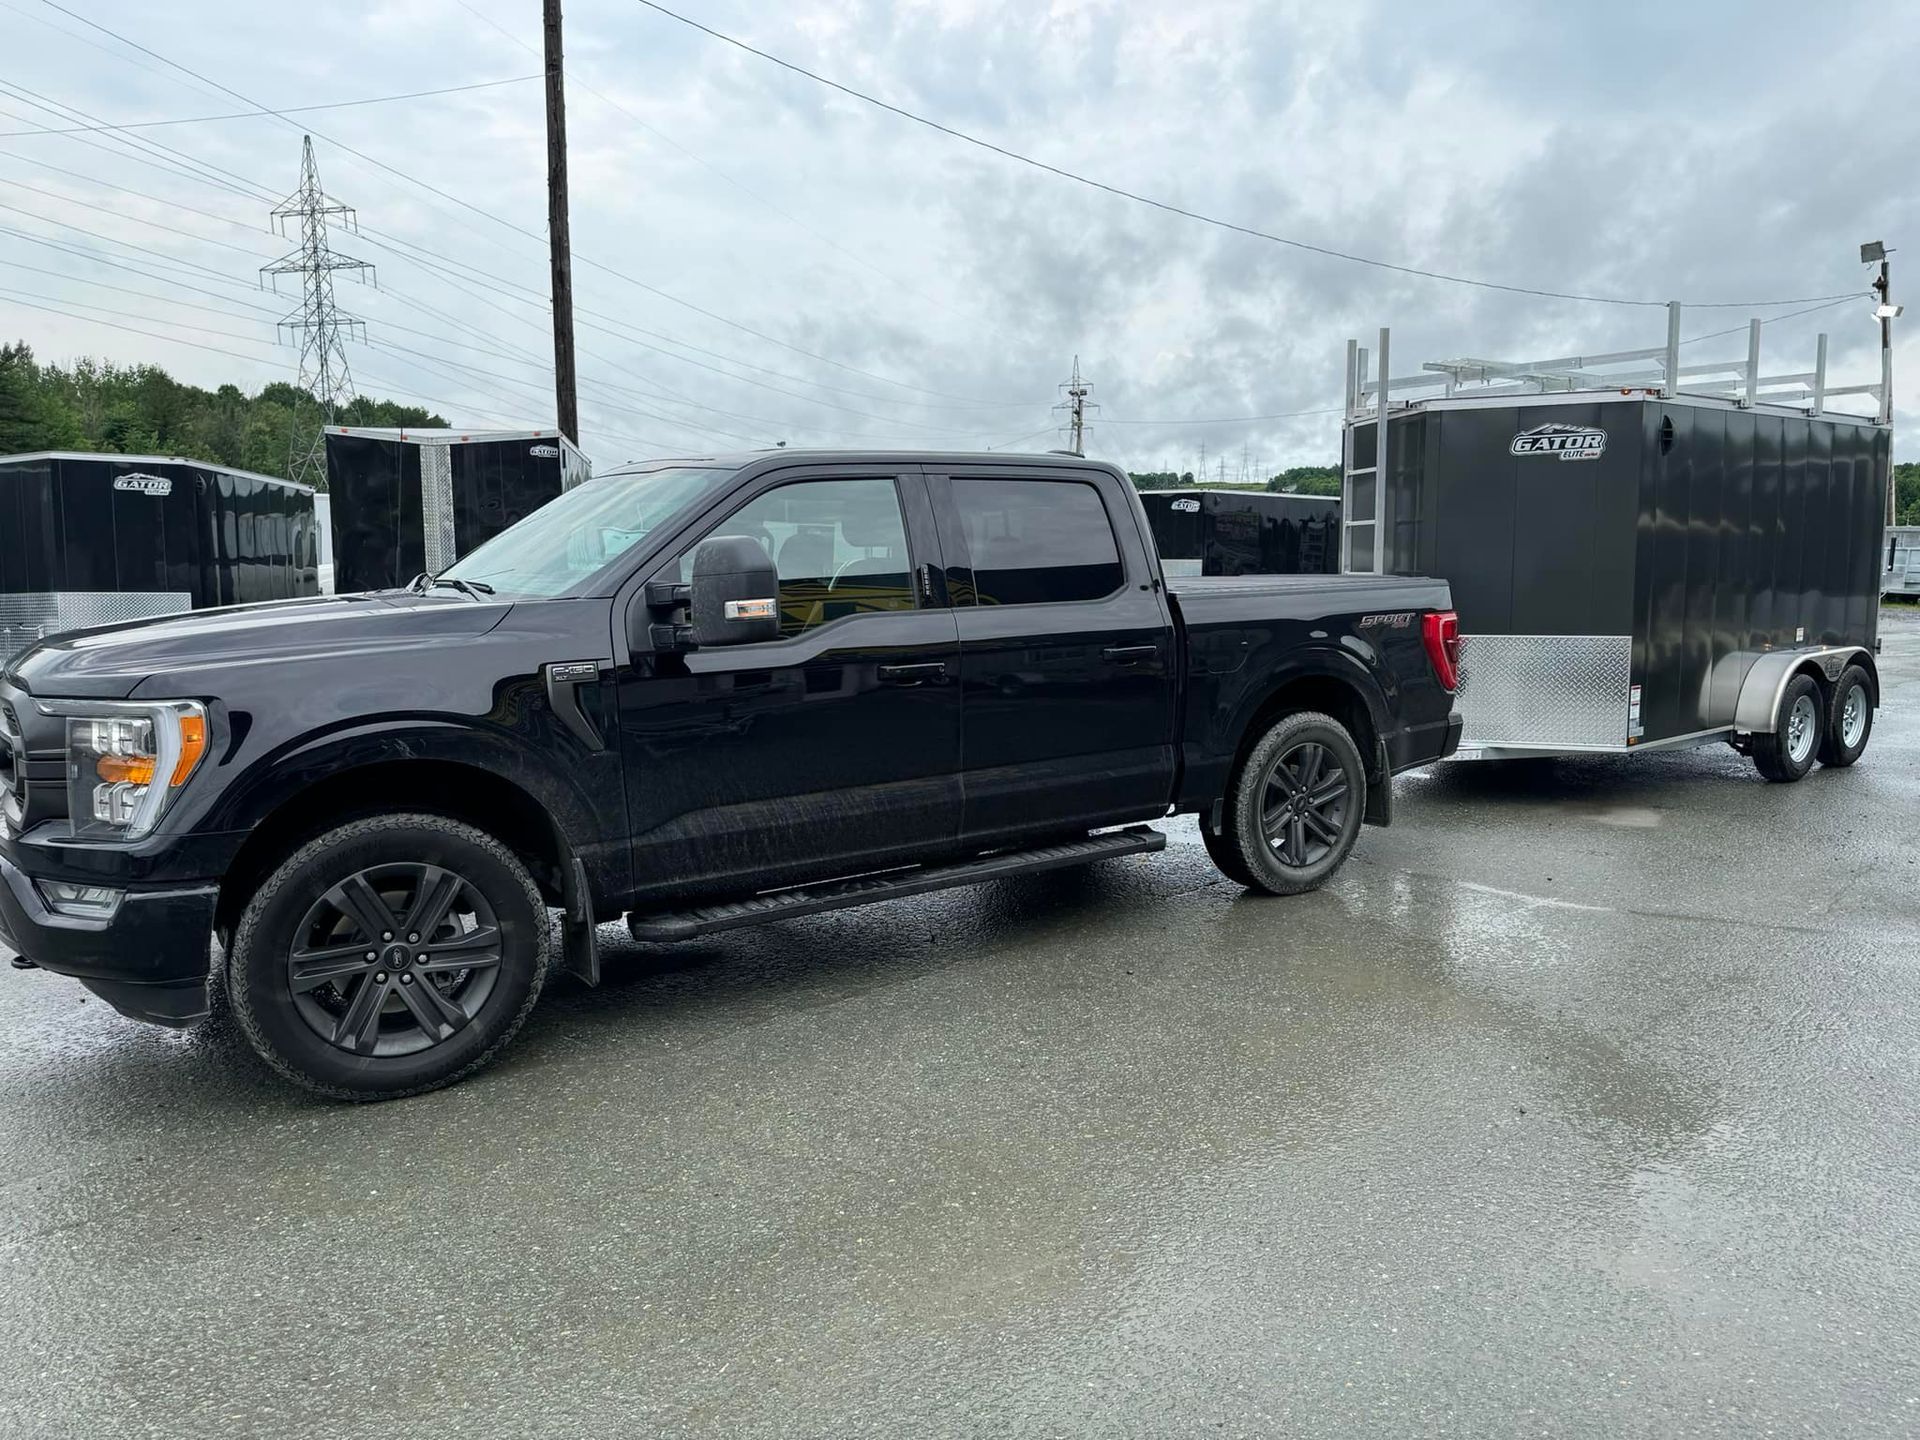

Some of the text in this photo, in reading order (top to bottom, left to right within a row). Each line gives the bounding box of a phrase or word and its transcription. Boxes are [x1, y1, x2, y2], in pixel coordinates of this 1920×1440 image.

[1513, 435, 1602, 451] GATOR
[1563, 450, 1584, 458] ELITE
[116, 480, 169, 490] GATOR
[1359, 613, 1416, 627] SPORT
